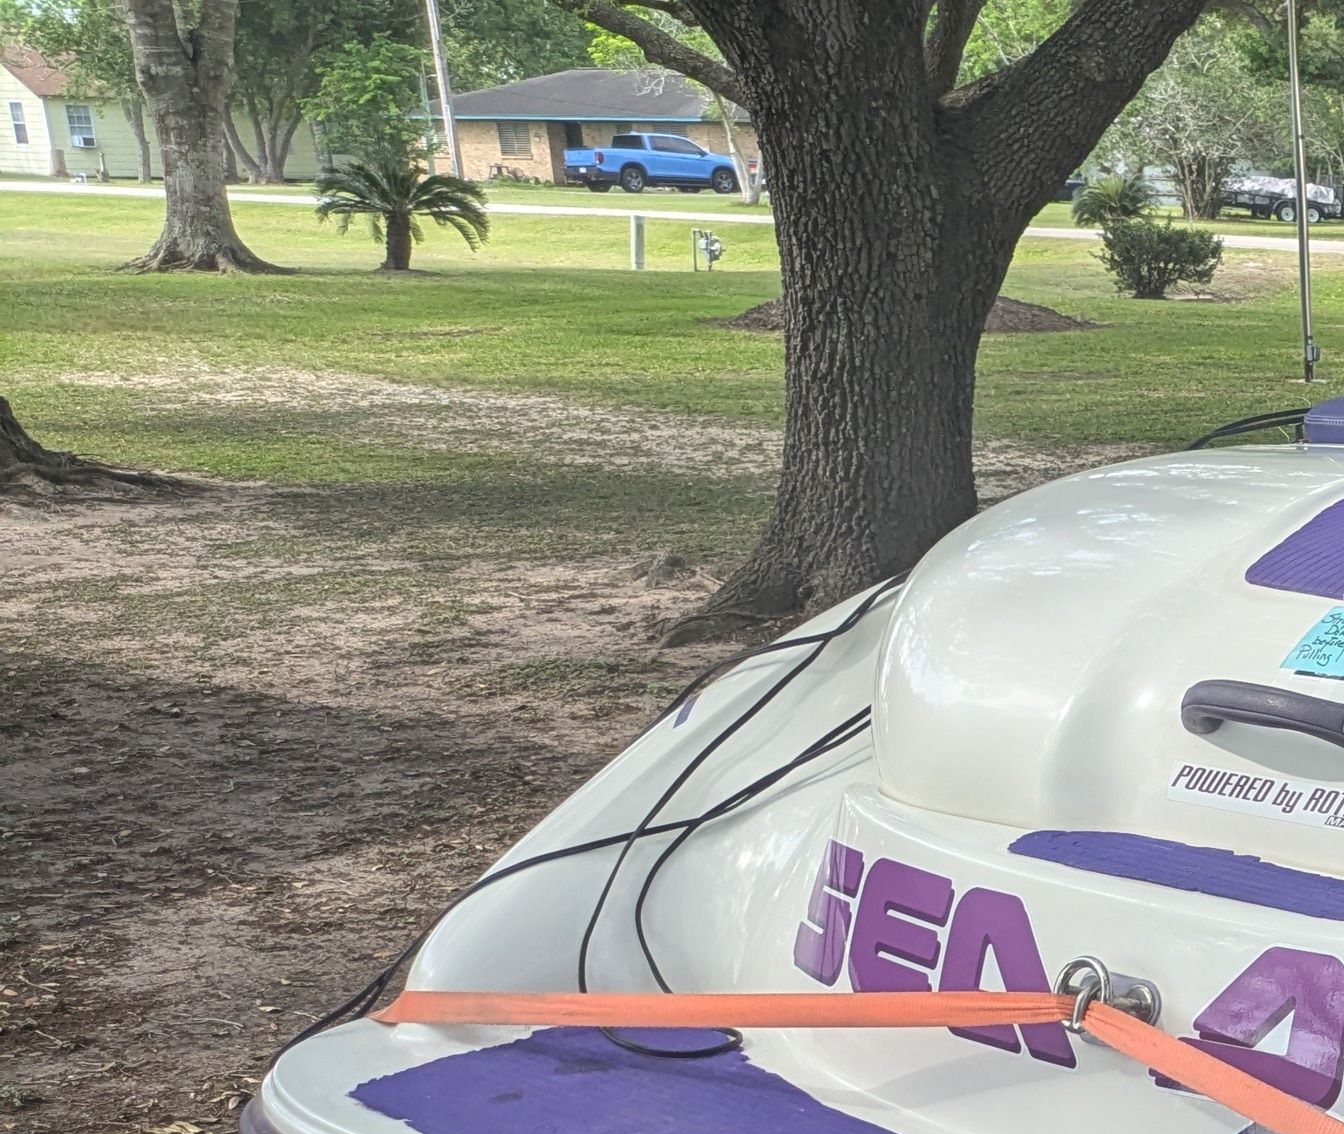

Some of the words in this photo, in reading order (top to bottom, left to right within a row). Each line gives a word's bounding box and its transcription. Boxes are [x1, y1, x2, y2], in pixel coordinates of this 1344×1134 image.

[1171, 764, 1275, 803] POWERED
[1271, 782, 1303, 814] by
[793, 838, 1076, 1068] SEA
